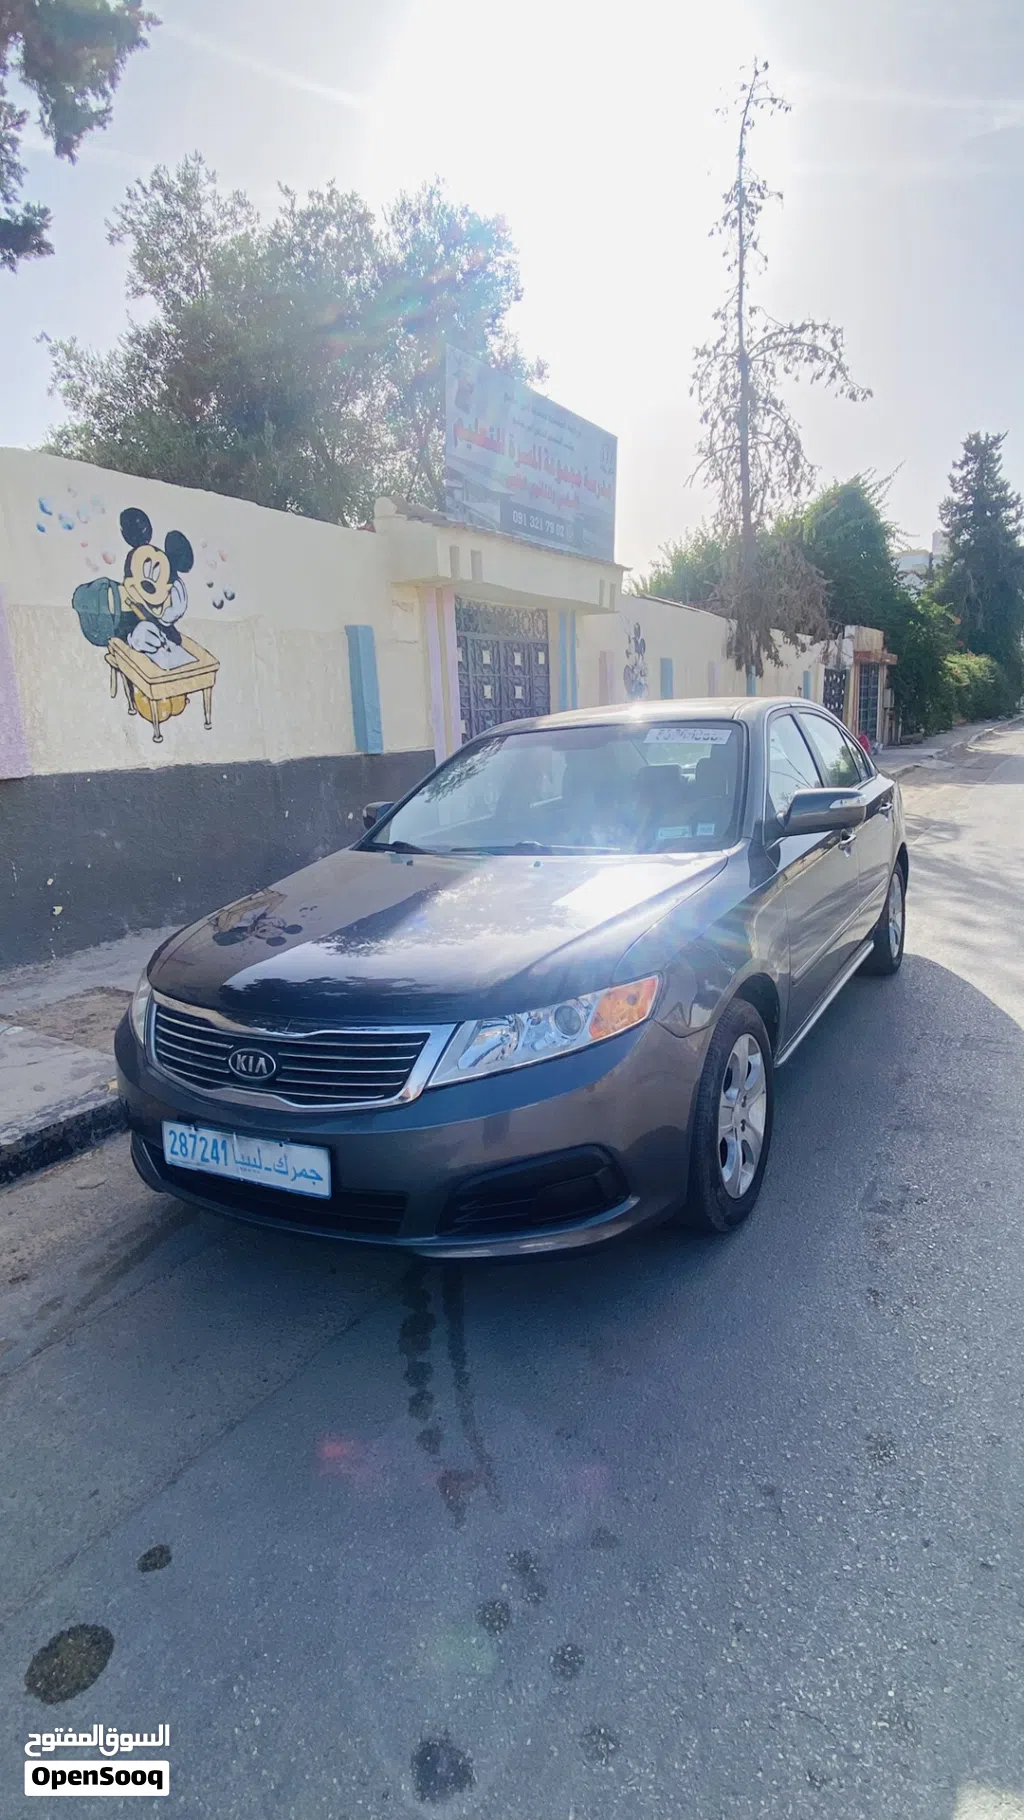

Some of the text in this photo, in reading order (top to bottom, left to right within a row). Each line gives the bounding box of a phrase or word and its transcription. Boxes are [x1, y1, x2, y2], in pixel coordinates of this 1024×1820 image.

[512, 510, 527, 526] 091
[529, 515, 544, 531] 321
[236, 1054, 268, 1075] KIA
[168, 1129, 228, 1166] 287241
